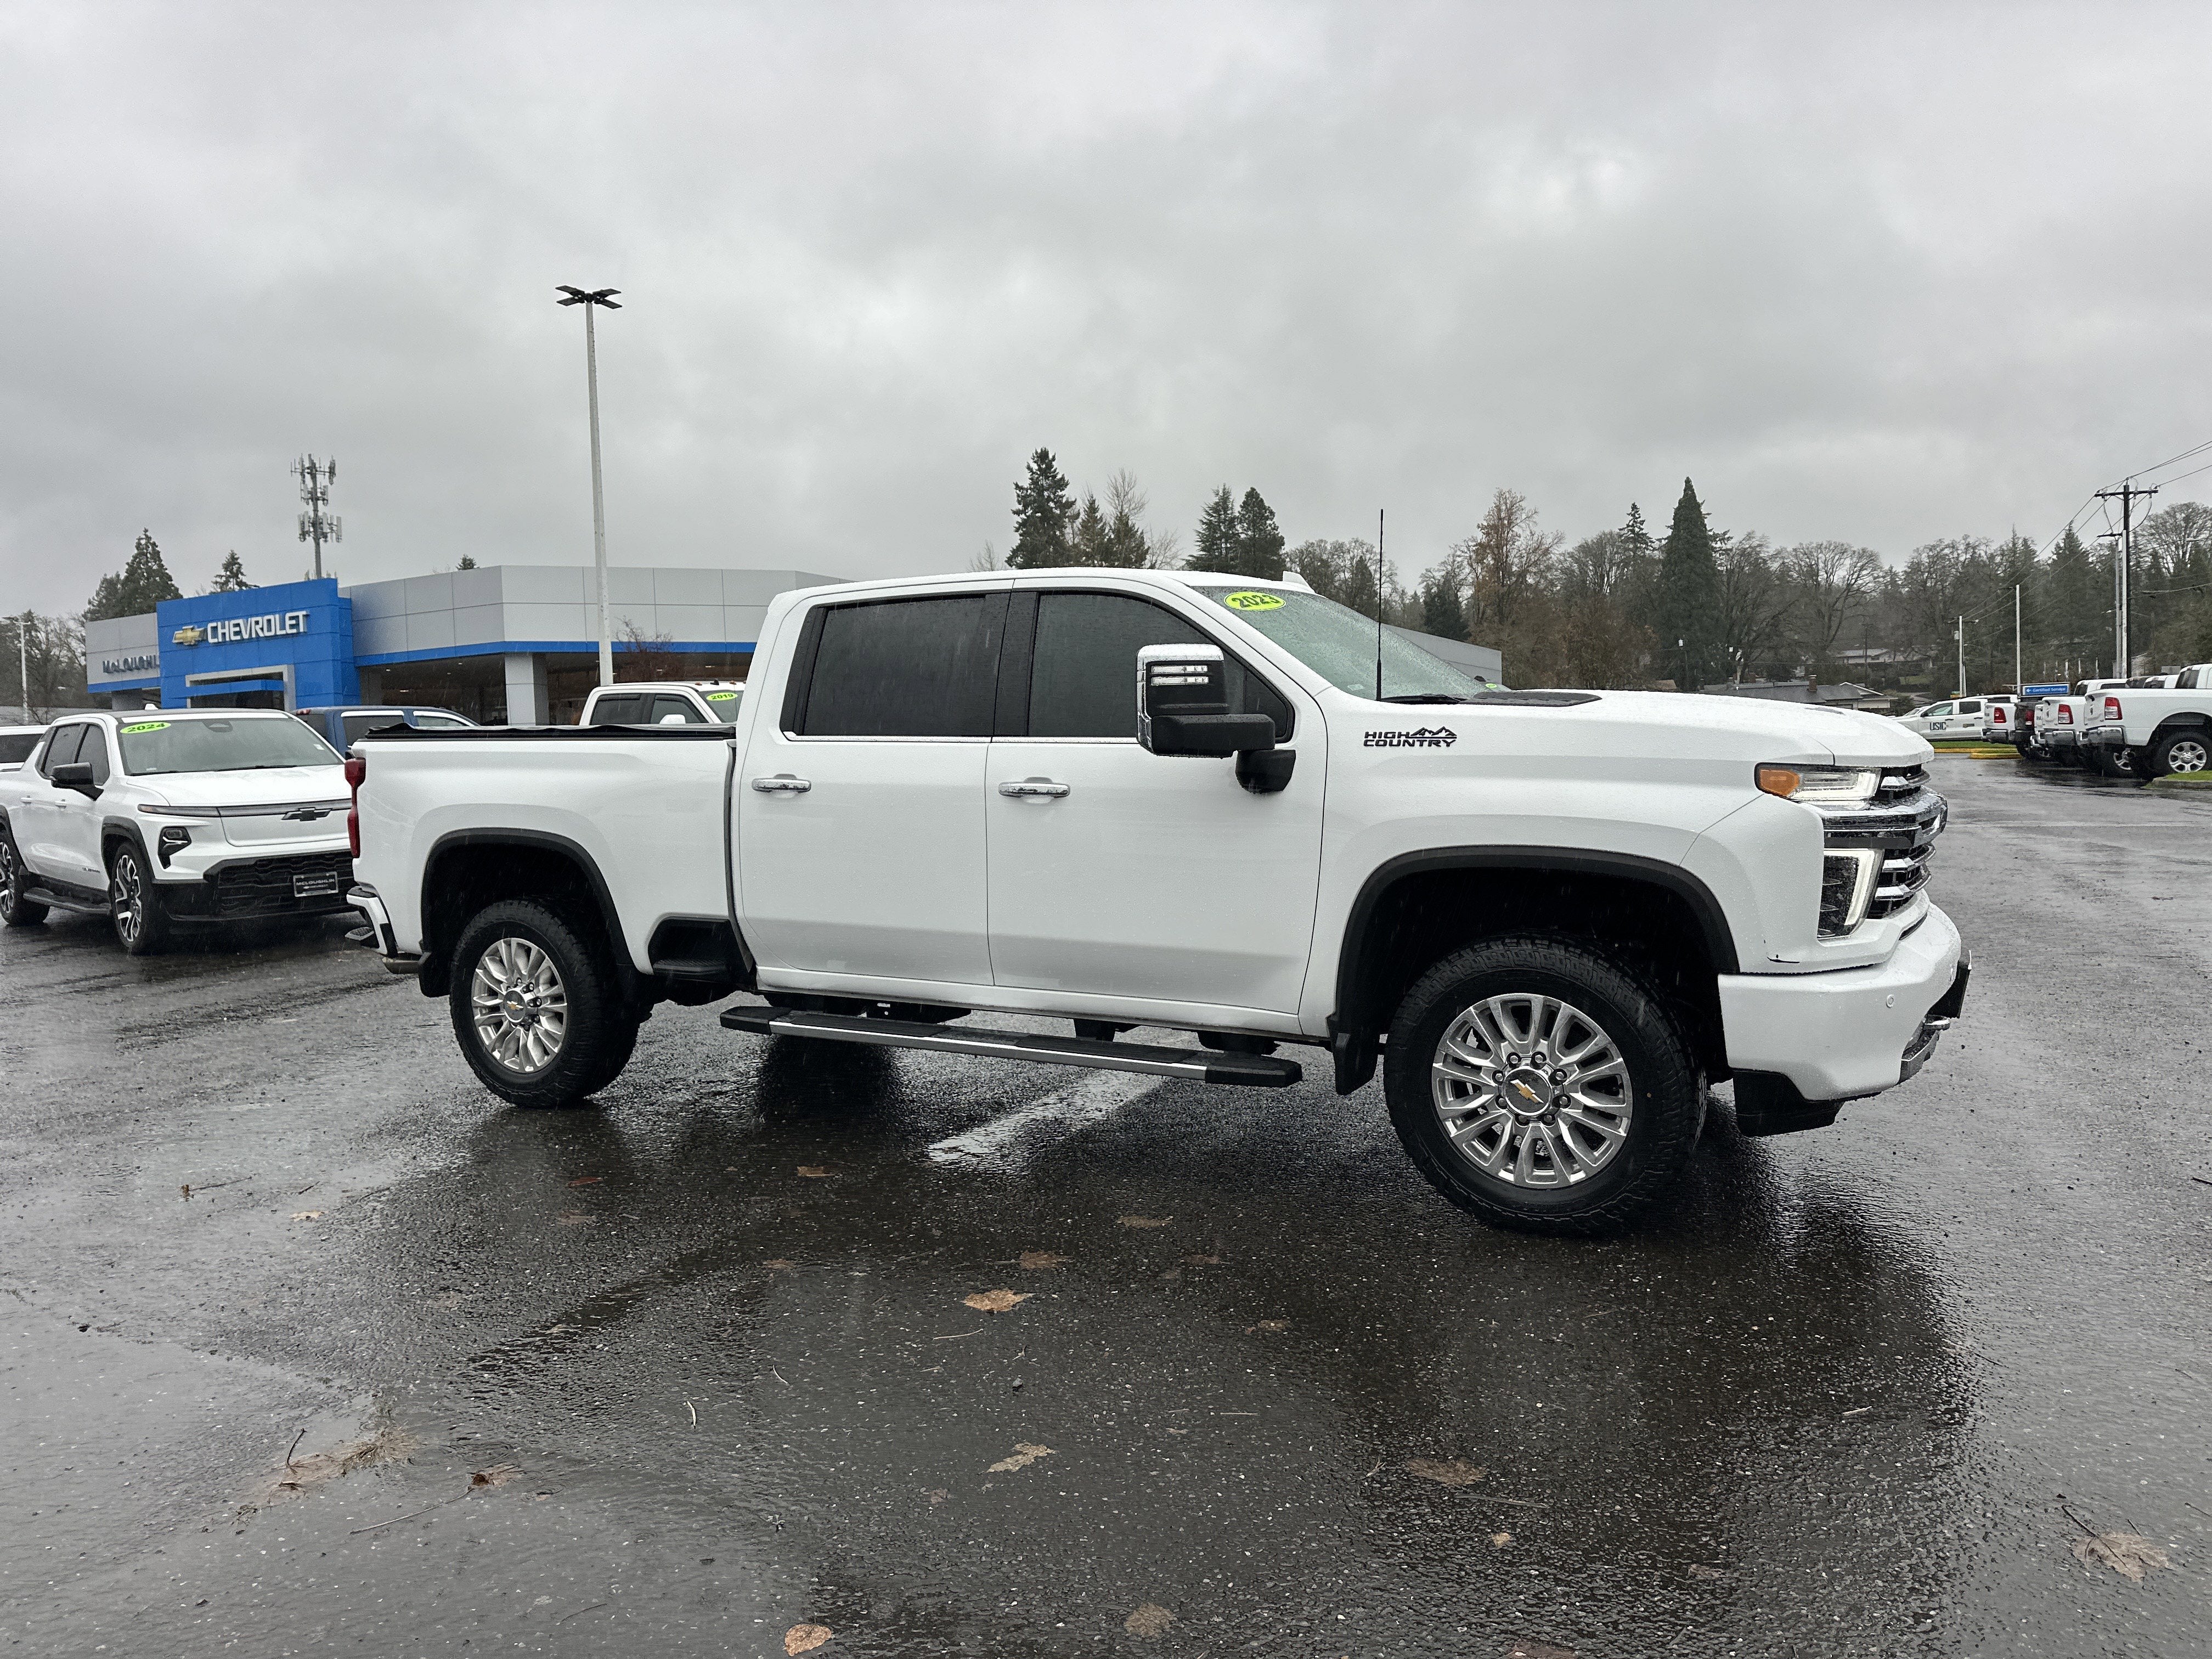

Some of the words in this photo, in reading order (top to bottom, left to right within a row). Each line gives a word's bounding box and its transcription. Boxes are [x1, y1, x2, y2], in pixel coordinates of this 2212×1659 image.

[1231, 594, 1281, 608] 2023
[207, 610, 307, 643] CHEVROLET
[127, 723, 165, 732] 2024
